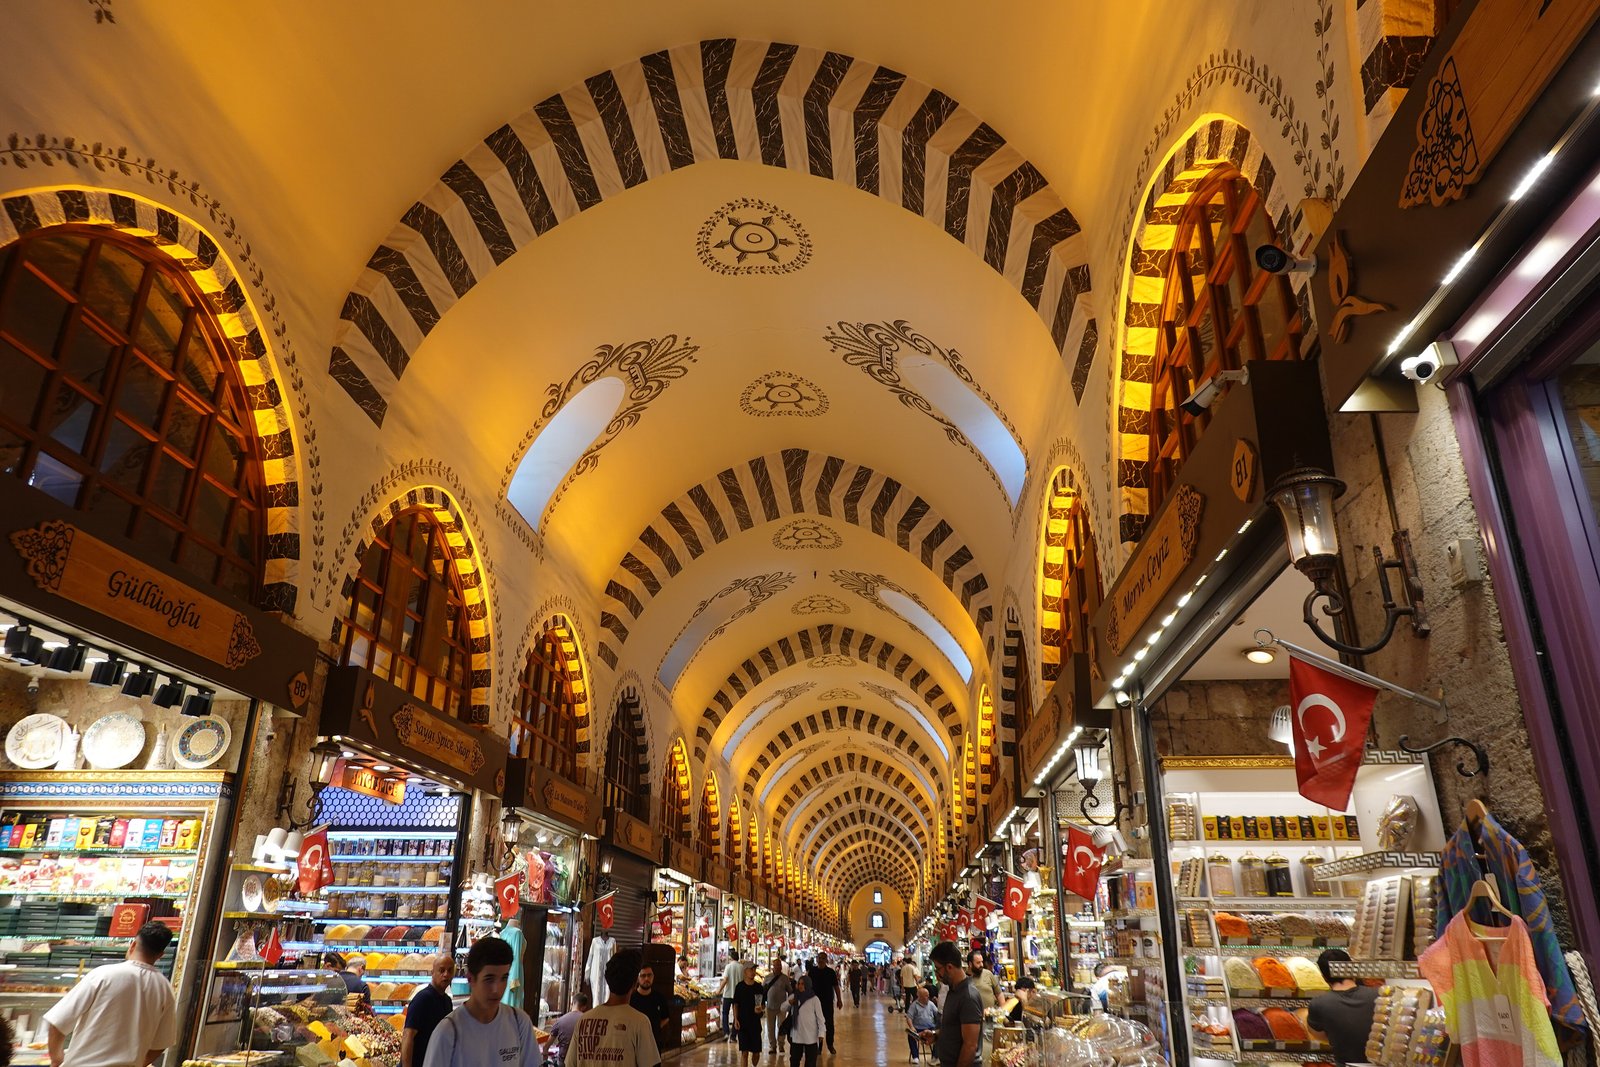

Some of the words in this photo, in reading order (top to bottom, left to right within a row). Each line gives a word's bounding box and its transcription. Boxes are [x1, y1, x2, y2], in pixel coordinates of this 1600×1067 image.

[1235, 452, 1248, 488] 81
[1123, 574, 1146, 620] Merve
[1147, 535, 1170, 588] Çeyiz
[107, 570, 201, 630] Güllüoğlu
[436, 731, 454, 750] Spice
[455, 740, 471, 761] Shop
[578, 1018, 609, 1036] NEVER
[578, 1035, 600, 1054] STOP
